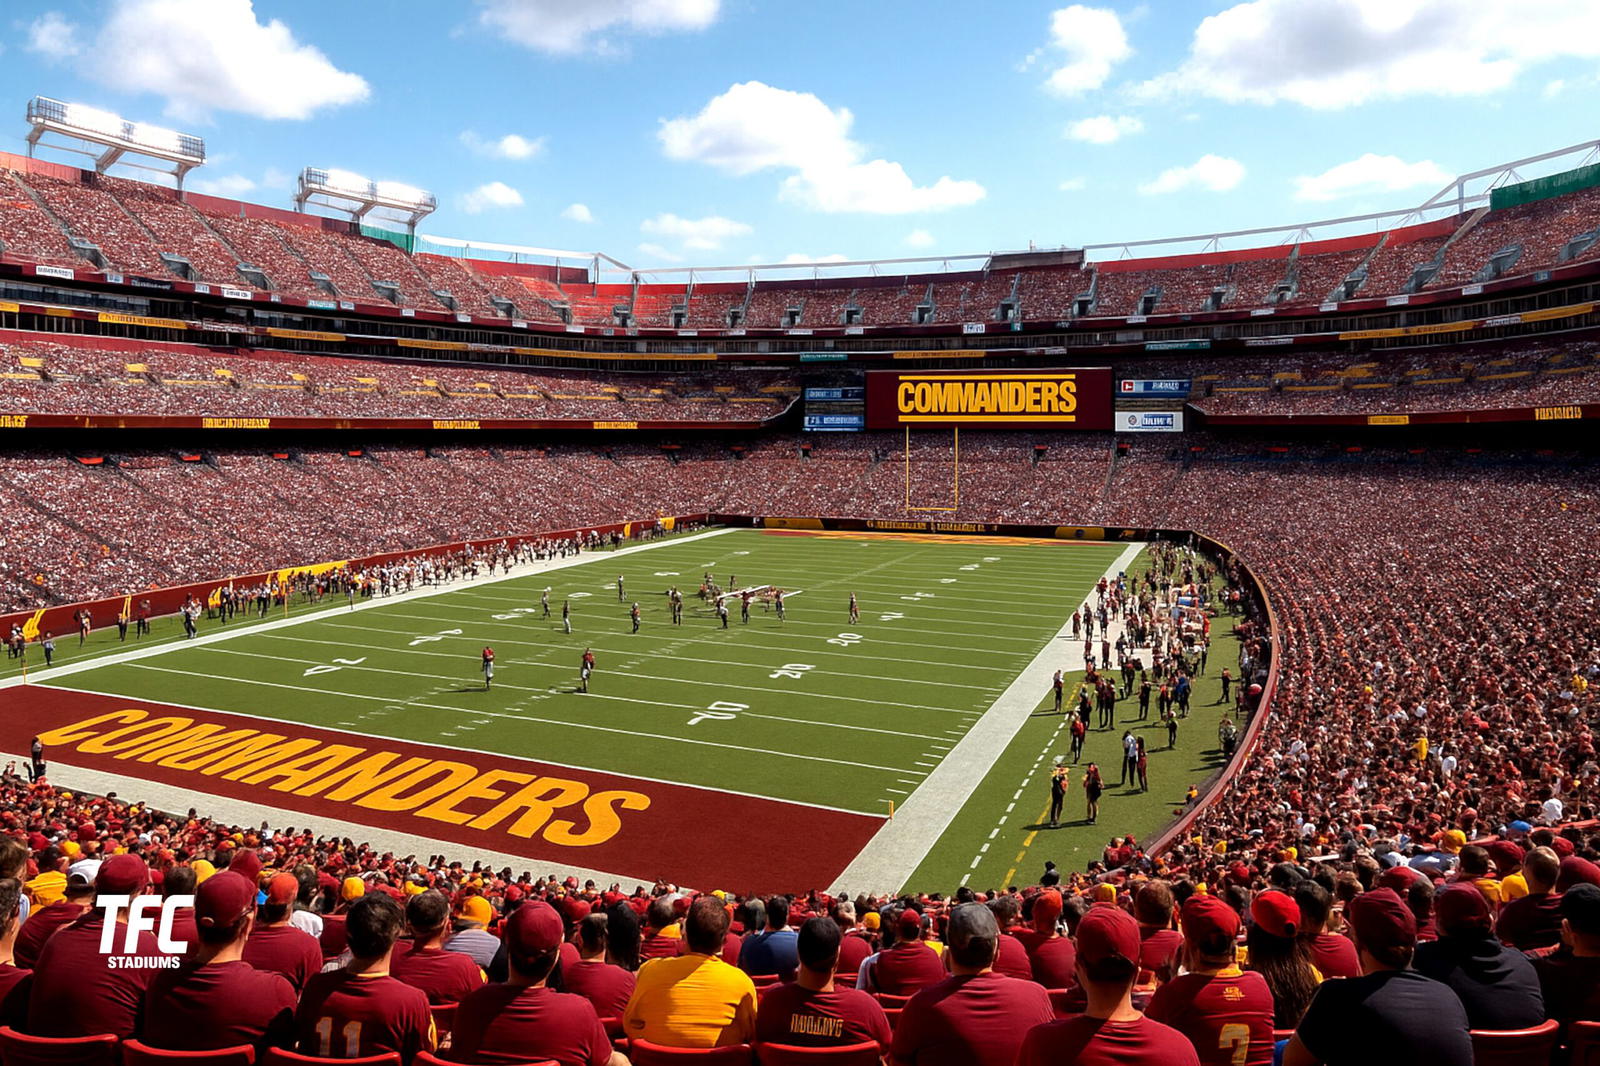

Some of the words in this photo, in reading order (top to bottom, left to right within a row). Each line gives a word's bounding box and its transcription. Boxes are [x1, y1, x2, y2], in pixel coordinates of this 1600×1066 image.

[898, 382, 1077, 413] COMMANDERS
[40, 708, 651, 847] COMMANDERS
[316, 1016, 362, 1057] 11
